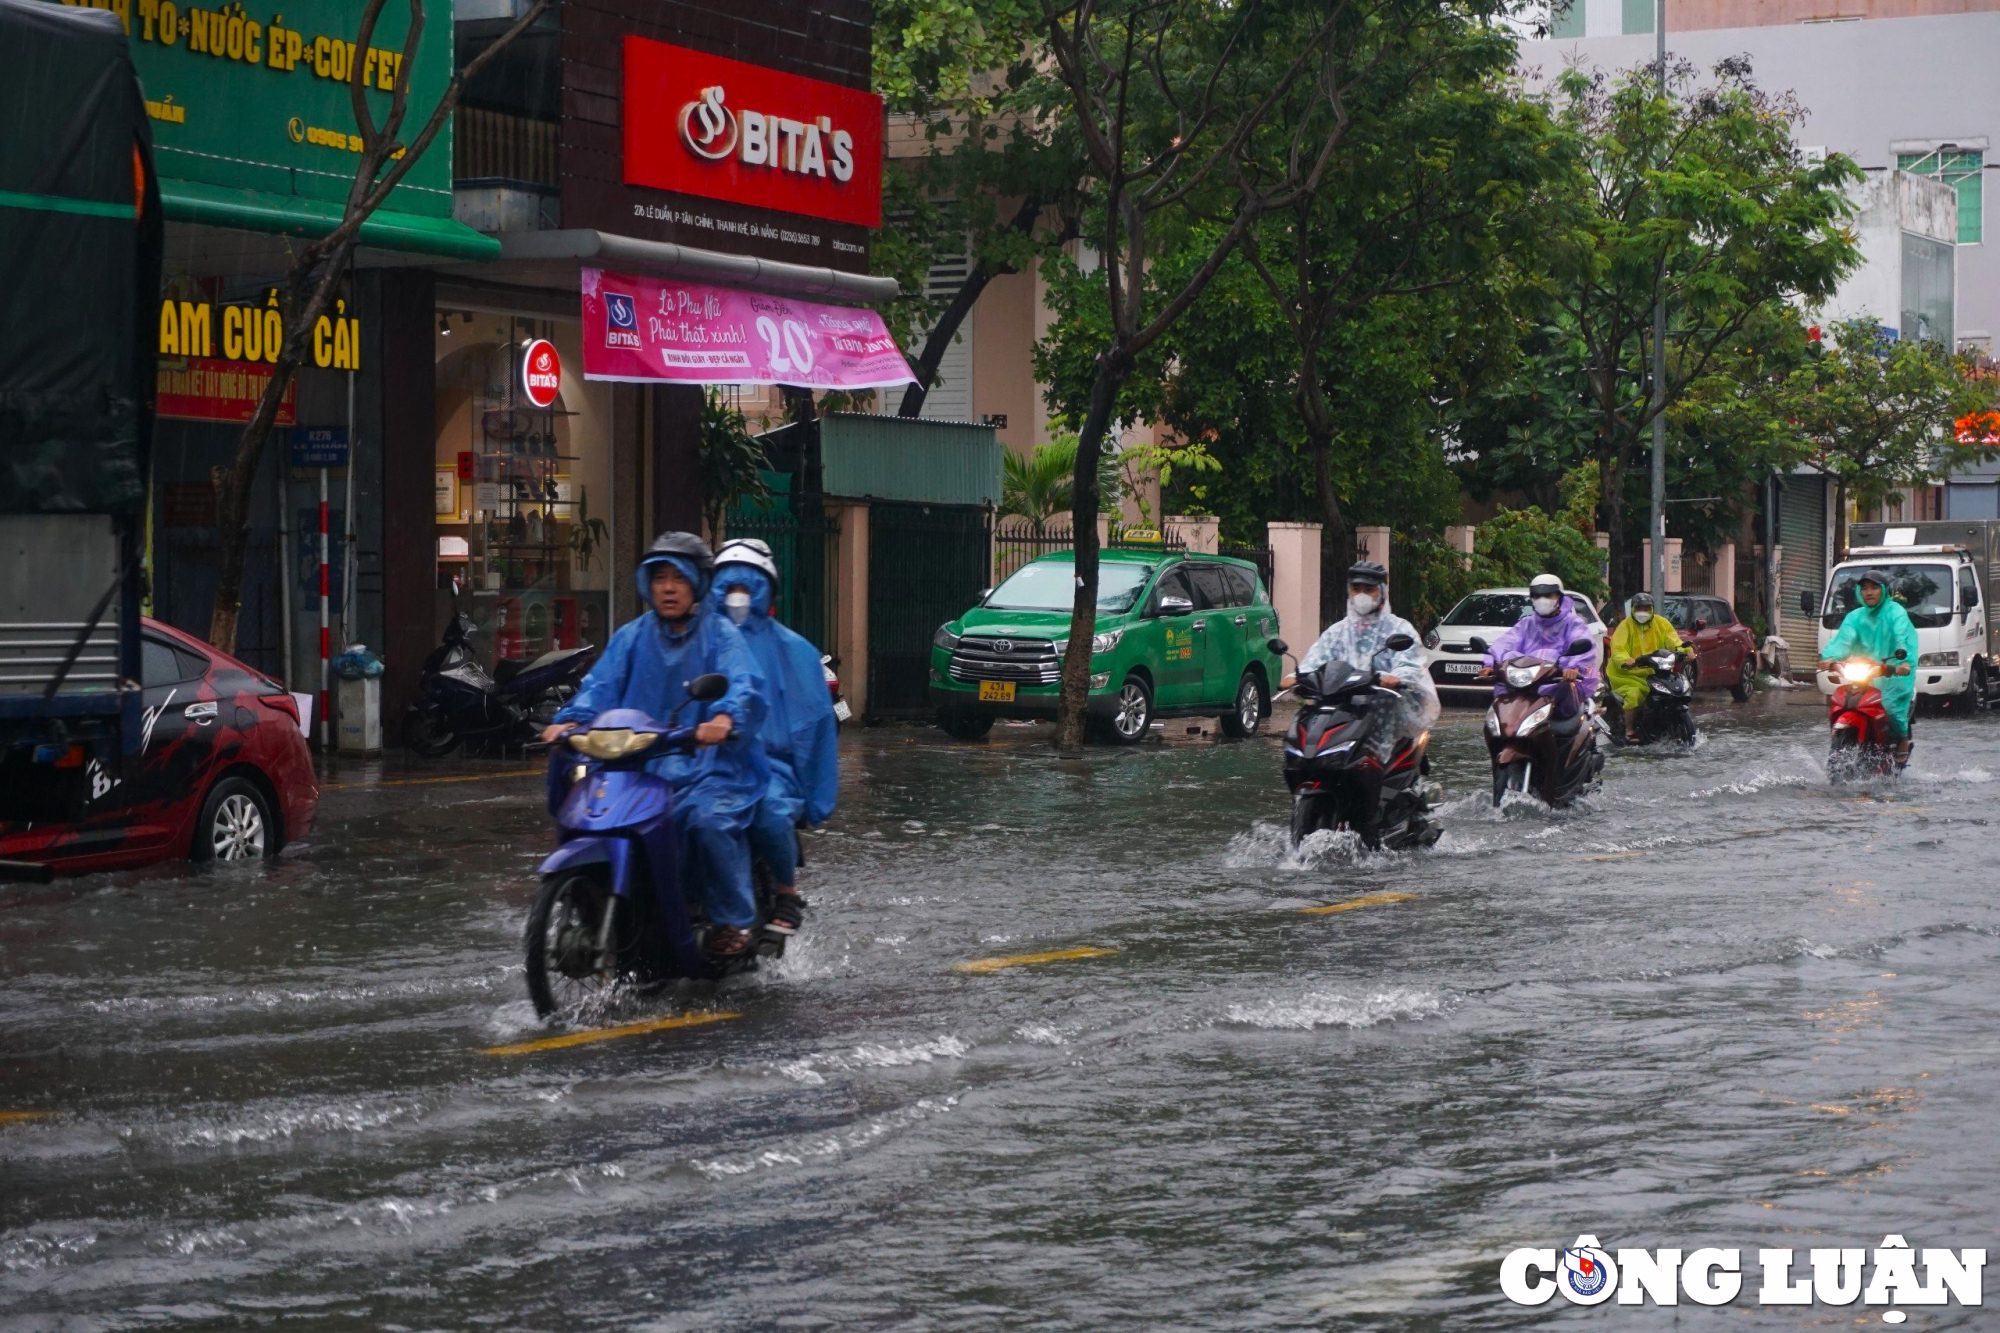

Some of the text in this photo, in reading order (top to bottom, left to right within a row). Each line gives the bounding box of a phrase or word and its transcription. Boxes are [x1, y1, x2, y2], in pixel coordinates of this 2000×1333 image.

[268, 14, 303, 71] ÉP
[307, 126, 347, 150] 0905
[737, 109, 854, 182] BITA'S
[677, 290, 702, 321] Phụ
[314, 299, 360, 370] CẢI
[529, 373, 558, 388] BITA'S
[983, 691, 1011, 700] 242.69
[990, 682, 1005, 691] 43A
